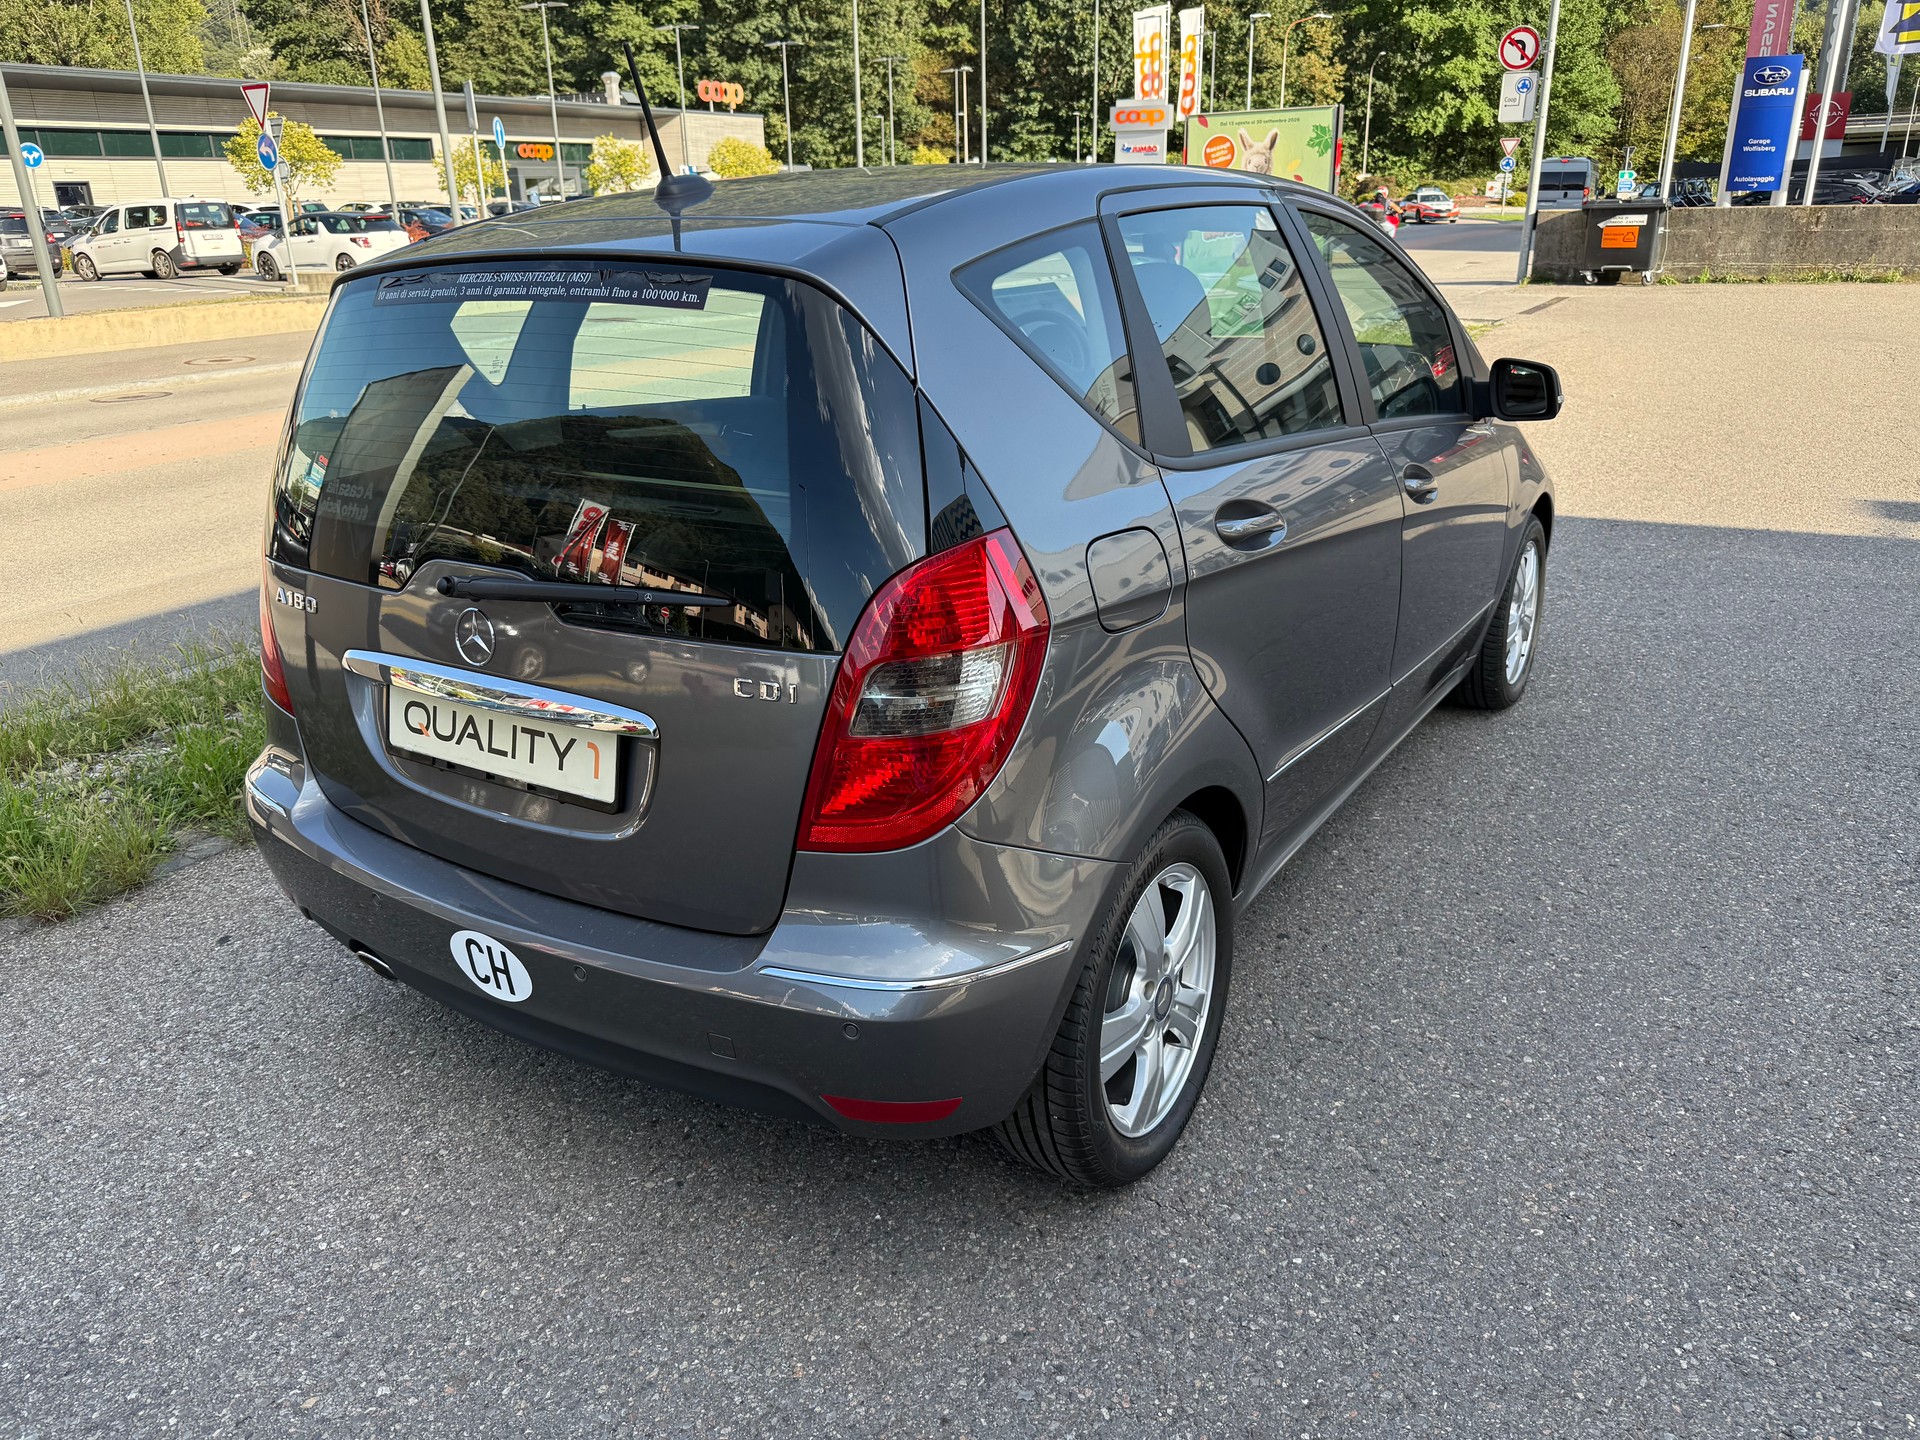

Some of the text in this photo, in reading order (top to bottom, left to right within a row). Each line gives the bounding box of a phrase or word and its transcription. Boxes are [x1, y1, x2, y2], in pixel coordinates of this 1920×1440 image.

[698, 79, 744, 109] coop
[1744, 87, 1795, 97] SUBARU
[1115, 109, 1165, 127] coop
[1132, 145, 1158, 153] JUMBO
[1743, 145, 1776, 153] Wolfisberg
[1748, 138, 1771, 146] Garage
[518, 143, 554, 161] coop
[1734, 175, 1775, 183] Autolavaggio
[457, 272, 592, 284] MERCEDES-SWISS-INTEGRAL (MSI)
[385, 290, 399, 299] anni
[400, 289, 407, 298] di
[408, 288, 430, 298] servizi
[430, 287, 458, 298] gratuiti,
[460, 287, 465, 295] 3
[466, 286, 483, 295] anni
[484, 286, 493, 295] di
[494, 286, 526, 298] garanzia
[529, 286, 567, 297] integrale,
[570, 286, 609, 297] entrambi
[612, 287, 630, 298] fino
[641, 289, 679, 300] 100'000
[681, 292, 700, 302] km.
[734, 677, 798, 704] CDI
[465, 938, 516, 996] CH
